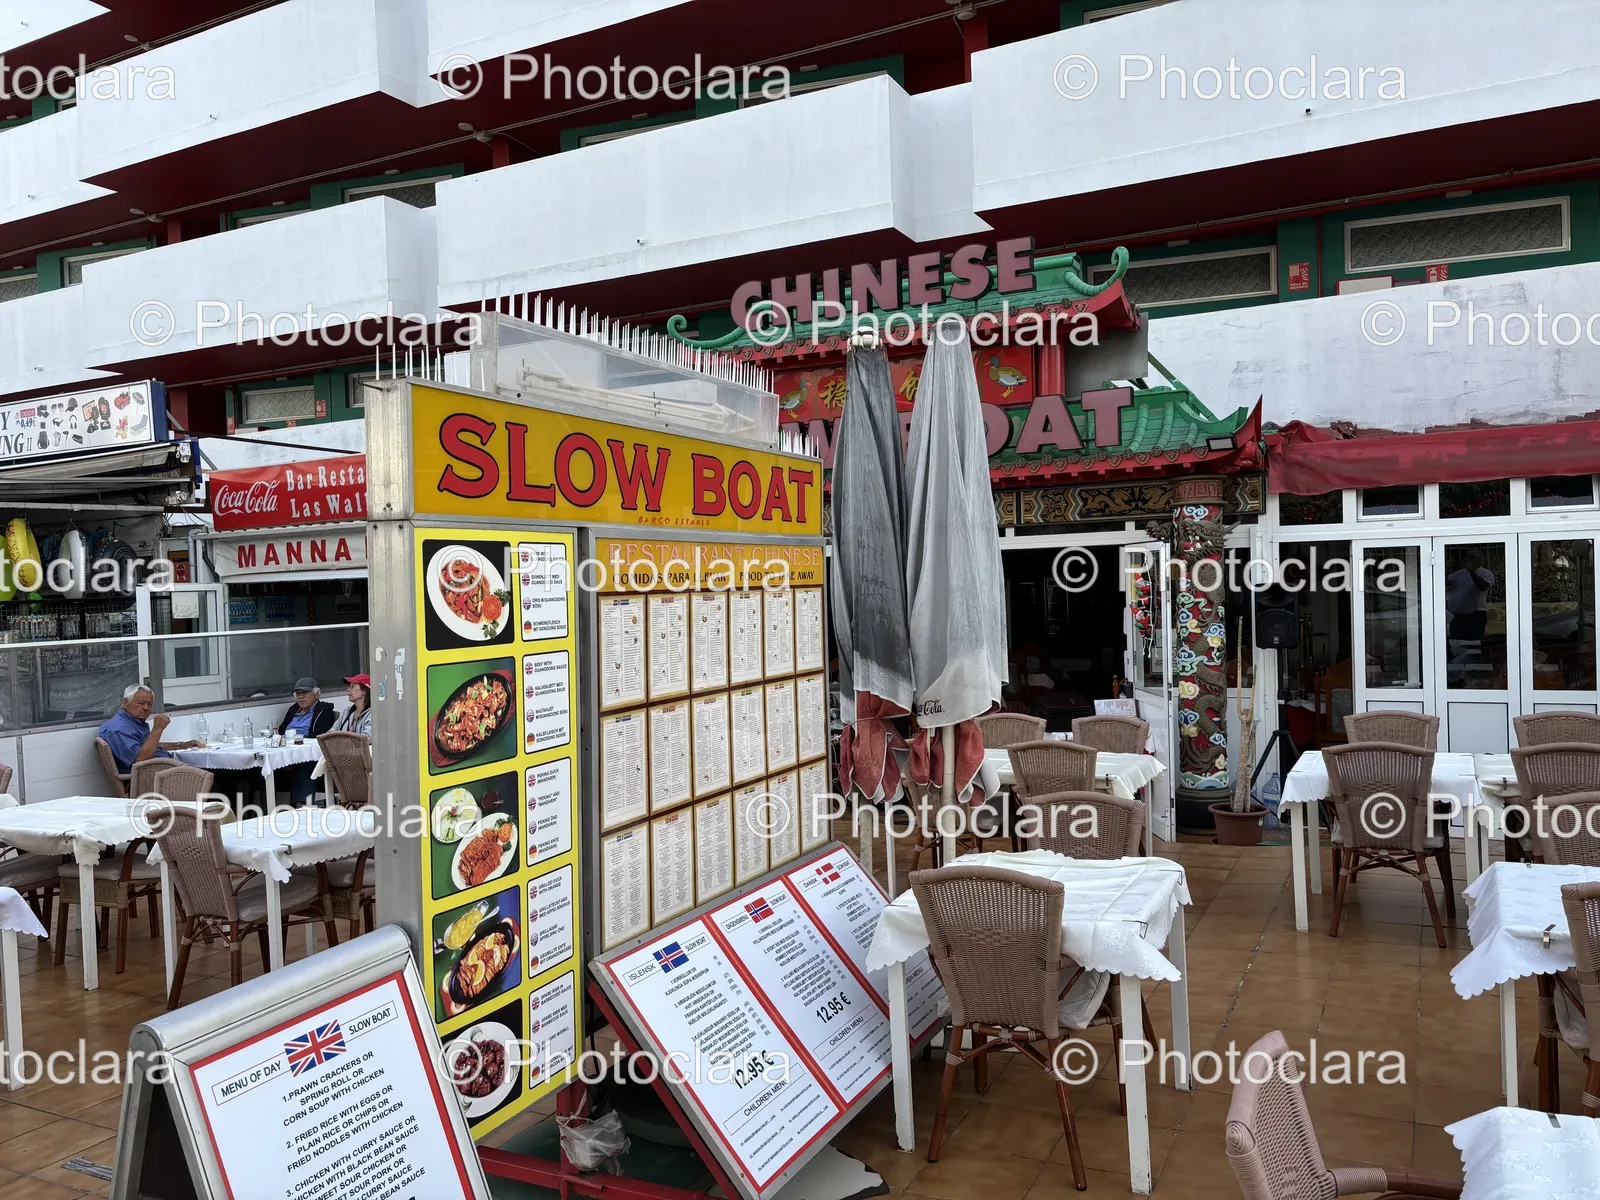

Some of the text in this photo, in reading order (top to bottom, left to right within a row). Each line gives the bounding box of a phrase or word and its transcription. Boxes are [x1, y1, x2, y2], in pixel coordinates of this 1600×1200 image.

[731, 237, 1034, 329] CHINESE
[286, 464, 364, 492] Bar Resta
[438, 412, 814, 524] SLOW BOAT
[290, 498, 321, 518] Las
[638, 516, 710, 526] BARCO ESTABLE
[237, 538, 352, 568] MANNA
[609, 543, 820, 566] RESTAURANT CHINESE
[612, 573, 662, 585] COMIDAS
[667, 573, 690, 584] PARA
[740, 572, 762, 582] FOOD
[797, 571, 815, 580] AWAY
[629, 936, 706, 981] ISLENSK SLOW BOAT
[817, 992, 851, 1023] 12.95 €
[827, 1016, 864, 1046] CHILDREN MENU
[221, 1008, 390, 1097] MENU OF DAY SLOW BOAT
[282, 1051, 374, 1102] 1.PRAWN CRACKERS OR
[300, 1068, 364, 1105] SPRING ROLL OR
[734, 1057, 764, 1089] 12.95
[284, 1068, 384, 1126] CORN SOUP WITH CHICKEN
[295, 1126, 318, 1144] FRIED
[320, 1115, 338, 1129] RICE
[339, 1103, 359, 1118] WITH
[360, 1092, 380, 1107] EGGS
[382, 1085, 393, 1094] OR
[744, 1090, 773, 1116] CHILDREN
[288, 1101, 403, 1172] FRIED NOODLES WITH CHICKEN
[297, 1098, 389, 1155] PLAIN RICE OR CHIPS OR
[294, 1124, 419, 1200] HICKEN WITH BLACK BEAN SAUCE
[295, 1166, 330, 1191] CHICKEN
[331, 1154, 351, 1169] WITH
[353, 1137, 377, 1157] CURRY
[379, 1122, 404, 1141] SAUCE
[405, 1115, 415, 1125] OR
[315, 1186, 337, 1200] WEET
[340, 1172, 361, 1189] SOUR
[363, 1151, 394, 1175] CHICKEN
[396, 1144, 407, 1154] OR
[349, 1158, 404, 1196] SOUR PORK OR
[361, 1164, 412, 1200] CURRY SAUCE
[380, 1167, 425, 1200] BEAN SAUCE
